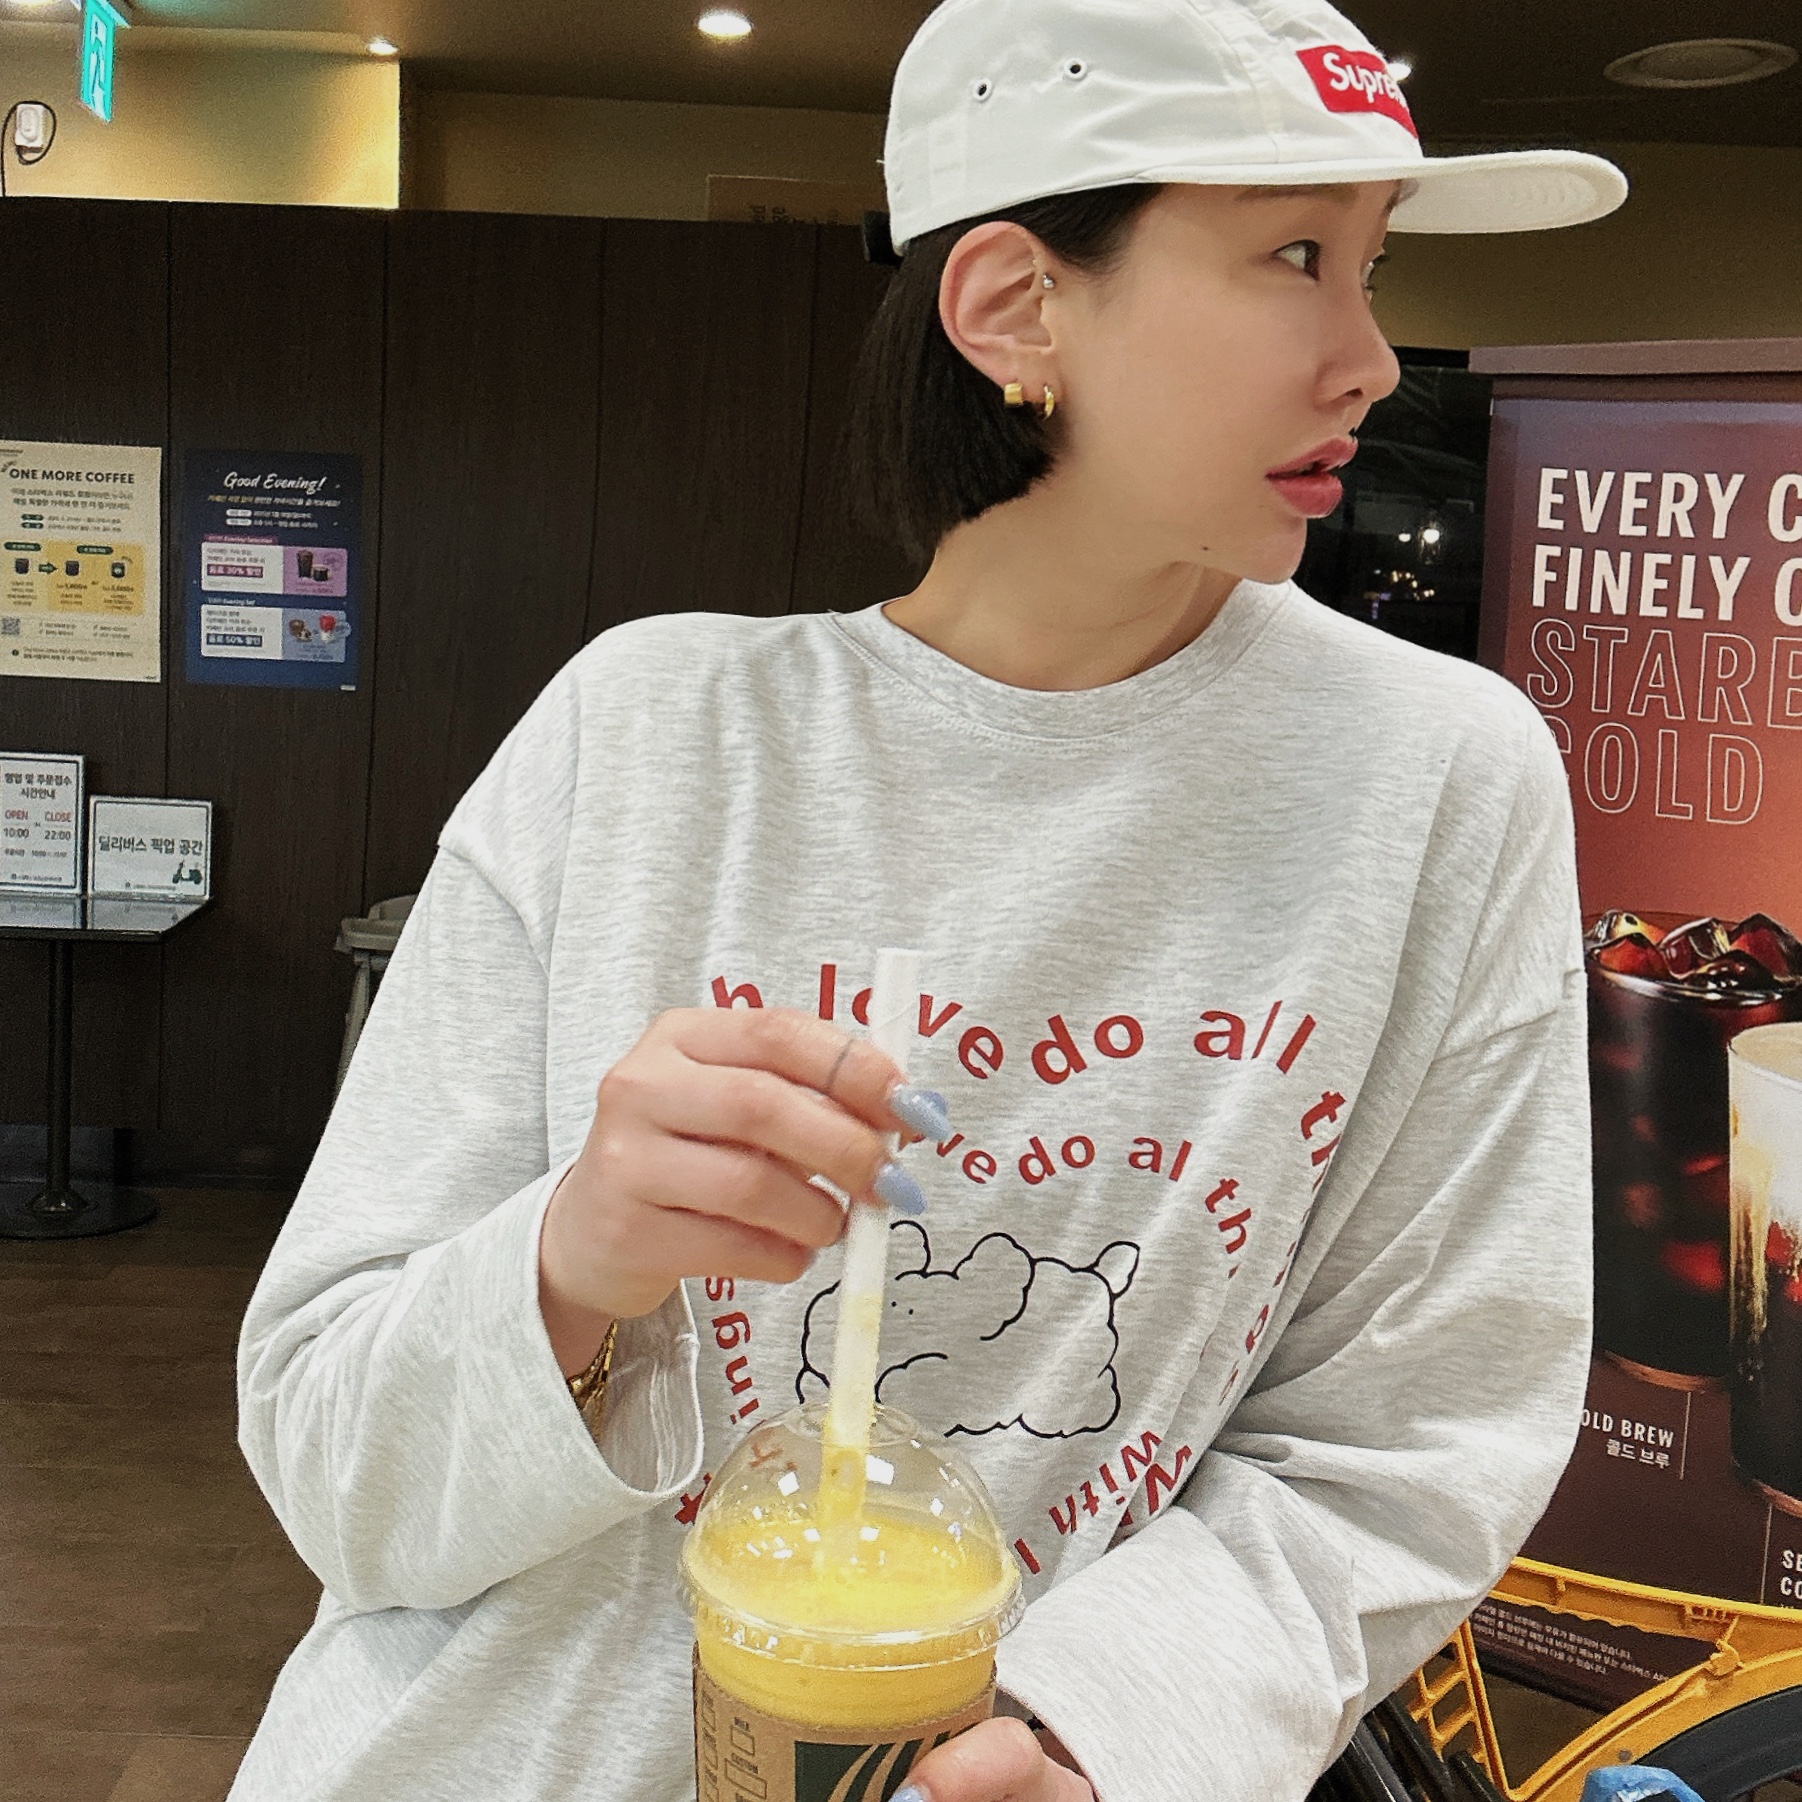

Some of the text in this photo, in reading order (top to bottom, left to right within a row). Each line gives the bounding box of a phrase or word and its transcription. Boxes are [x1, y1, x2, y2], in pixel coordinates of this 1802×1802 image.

[1322, 51, 1402, 104] Supre
[9, 468, 135, 484] ONE MORE COFFEE
[223, 471, 327, 496] Good Evening!
[1537, 467, 1745, 540] EVERY
[1532, 544, 1751, 622] FINELY
[21, 787, 56, 799] 시간안내
[5, 809, 72, 823] OPEN CLOSE
[4, 827, 71, 841] 10:00 22:00
[99, 836, 203, 856] 딜리버스 픽업 공간
[1621, 1419, 1674, 1448] BREW
[1606, 1438, 1671, 1470] 콜드 브루
